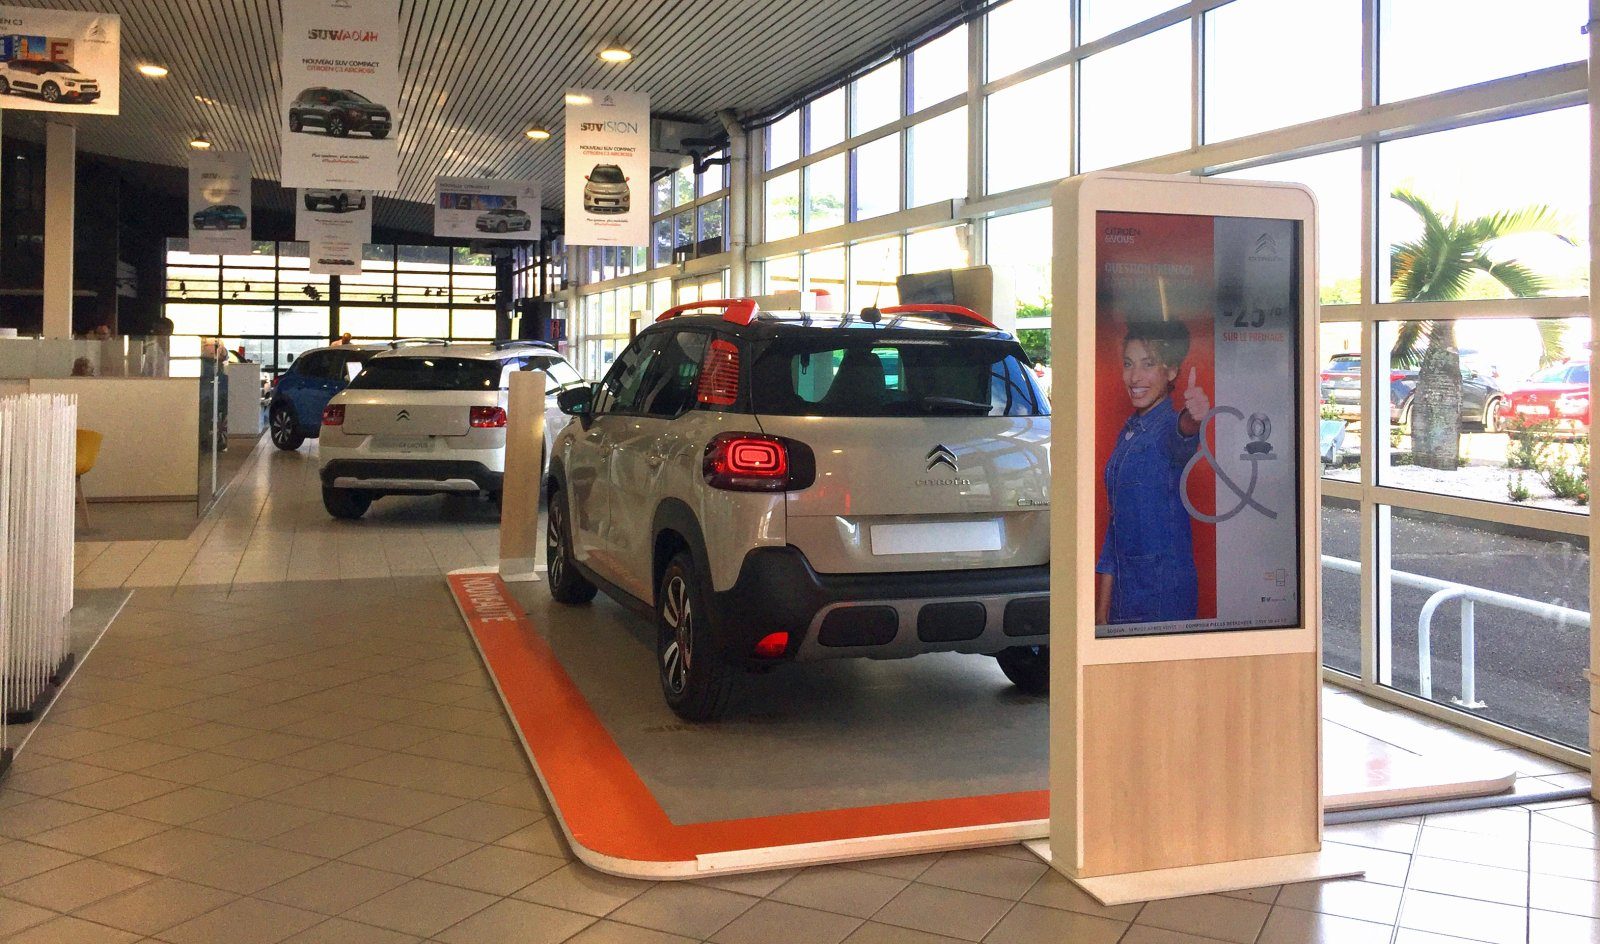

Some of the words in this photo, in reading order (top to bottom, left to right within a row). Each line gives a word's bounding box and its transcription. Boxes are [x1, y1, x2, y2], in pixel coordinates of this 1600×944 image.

[302, 58, 333, 66] NOUVEAU
[348, 60, 380, 68] COMPACT
[1223, 332, 1239, 342] SUR
